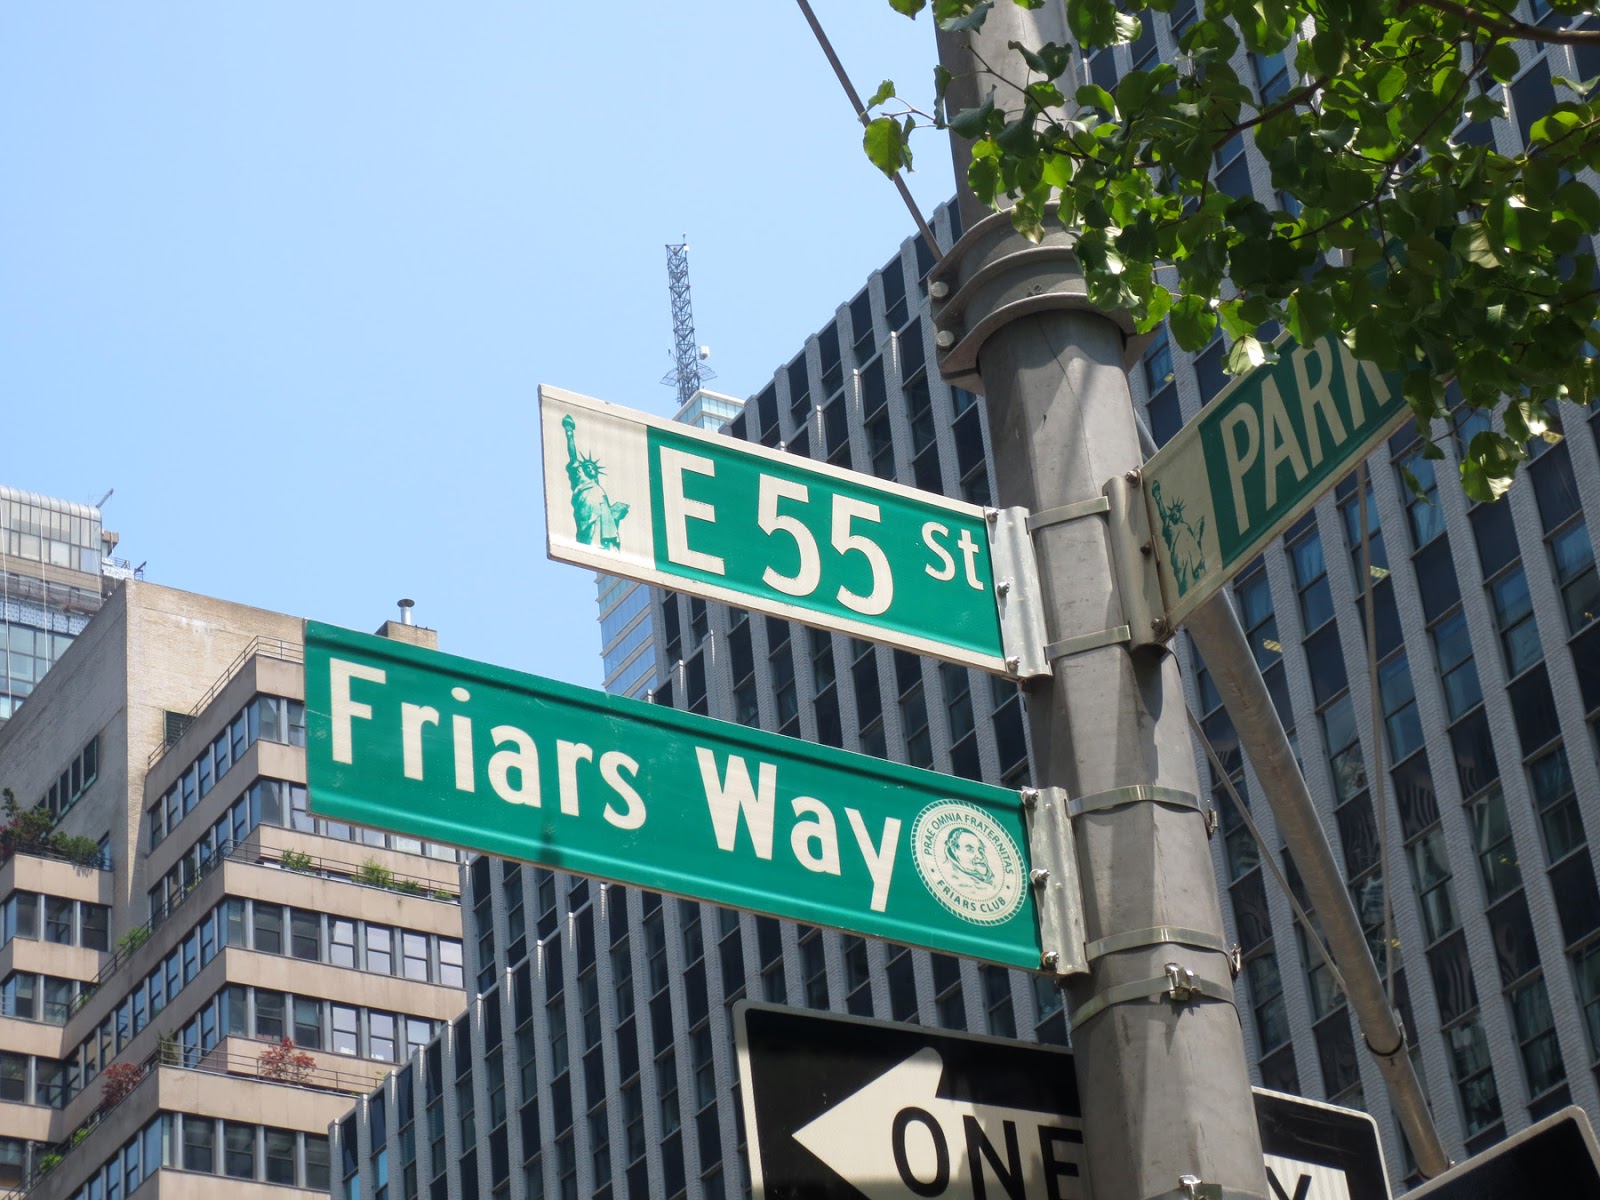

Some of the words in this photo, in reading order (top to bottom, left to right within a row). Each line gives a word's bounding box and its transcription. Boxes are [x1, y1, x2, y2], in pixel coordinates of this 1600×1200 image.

[659, 445, 725, 575] E
[757, 473, 894, 616] 55
[921, 521, 984, 590] St
[329, 657, 646, 830] Friars
[695, 746, 901, 912] Way
[923, 828, 936, 856] PRAE
[932, 812, 963, 829] OMNIA
[964, 814, 1014, 875] FRATERNITAS
[936, 880, 977, 911] FRIARS
[980, 896, 1006, 913] CLUB
[891, 1106, 1083, 1200] ONE
